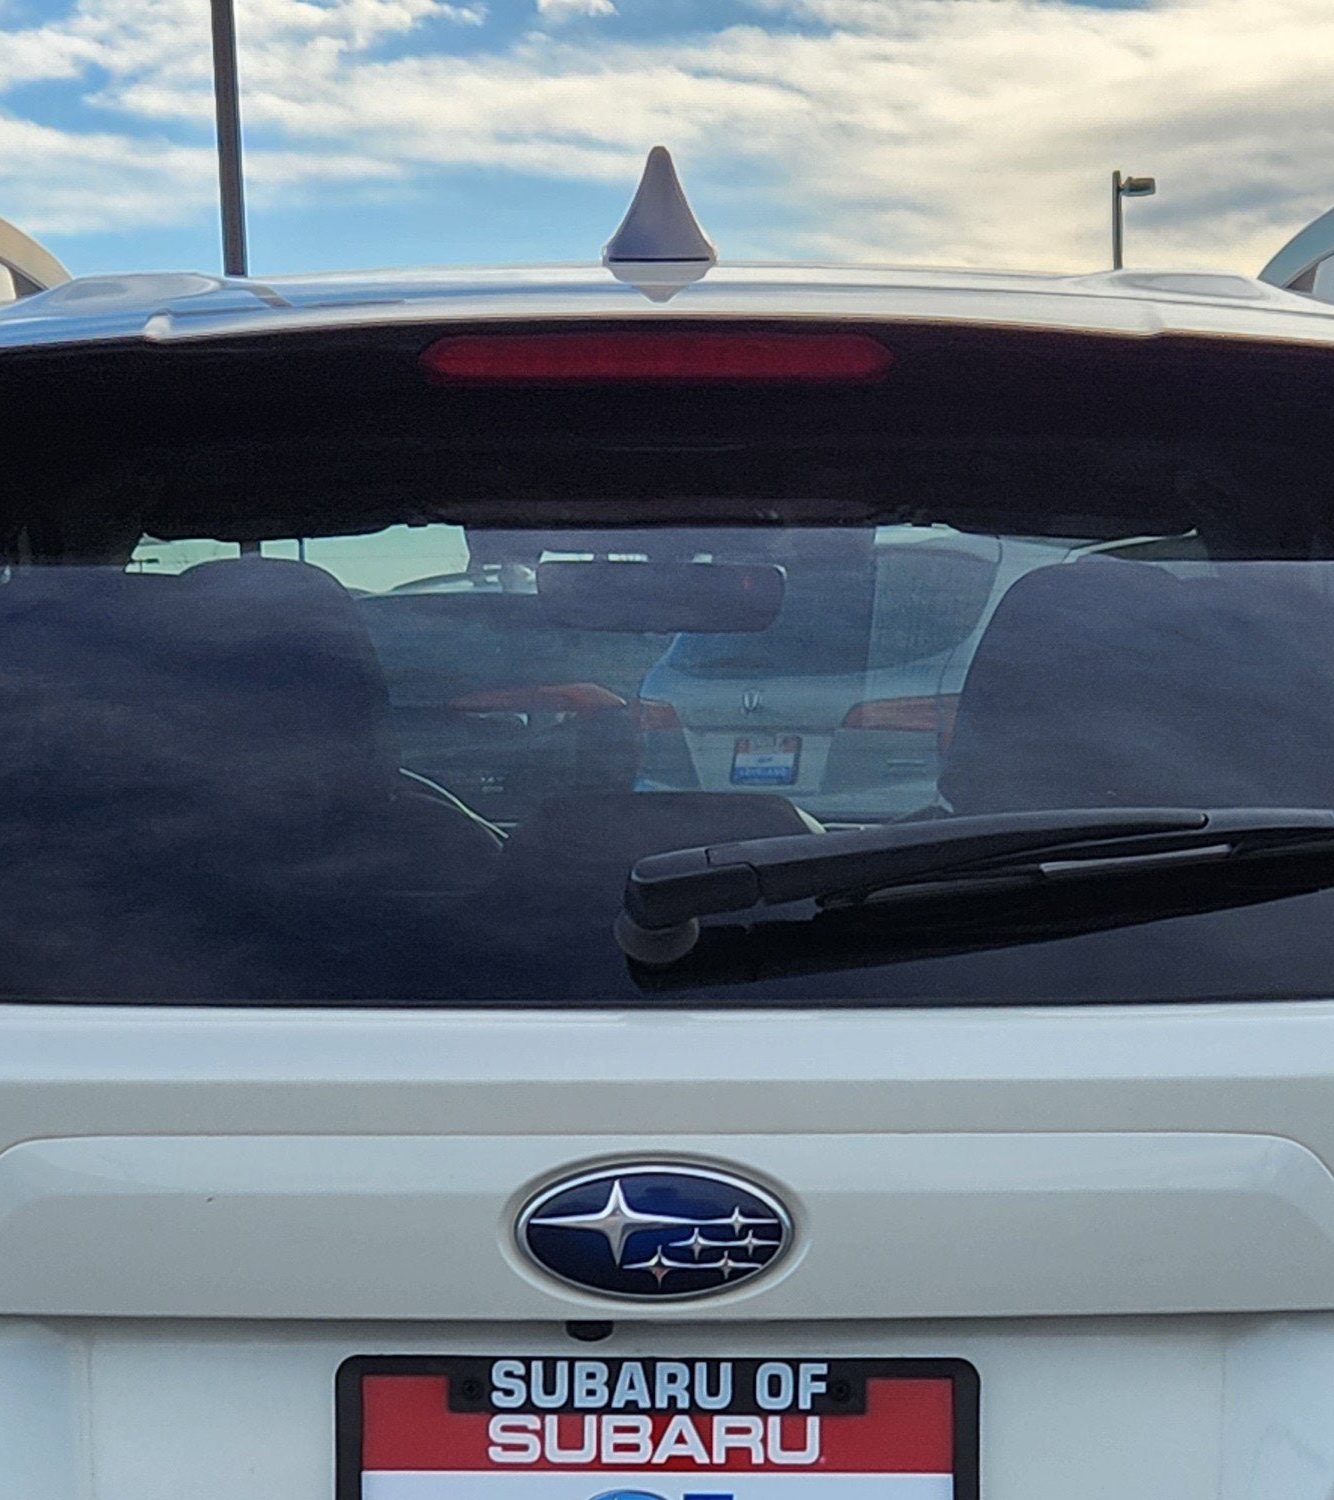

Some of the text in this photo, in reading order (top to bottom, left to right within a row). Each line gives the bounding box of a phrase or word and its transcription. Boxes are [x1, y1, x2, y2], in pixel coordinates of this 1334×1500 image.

[491, 1361, 829, 1411] SUBARU OF
[488, 1414, 821, 1465] SUBARU
